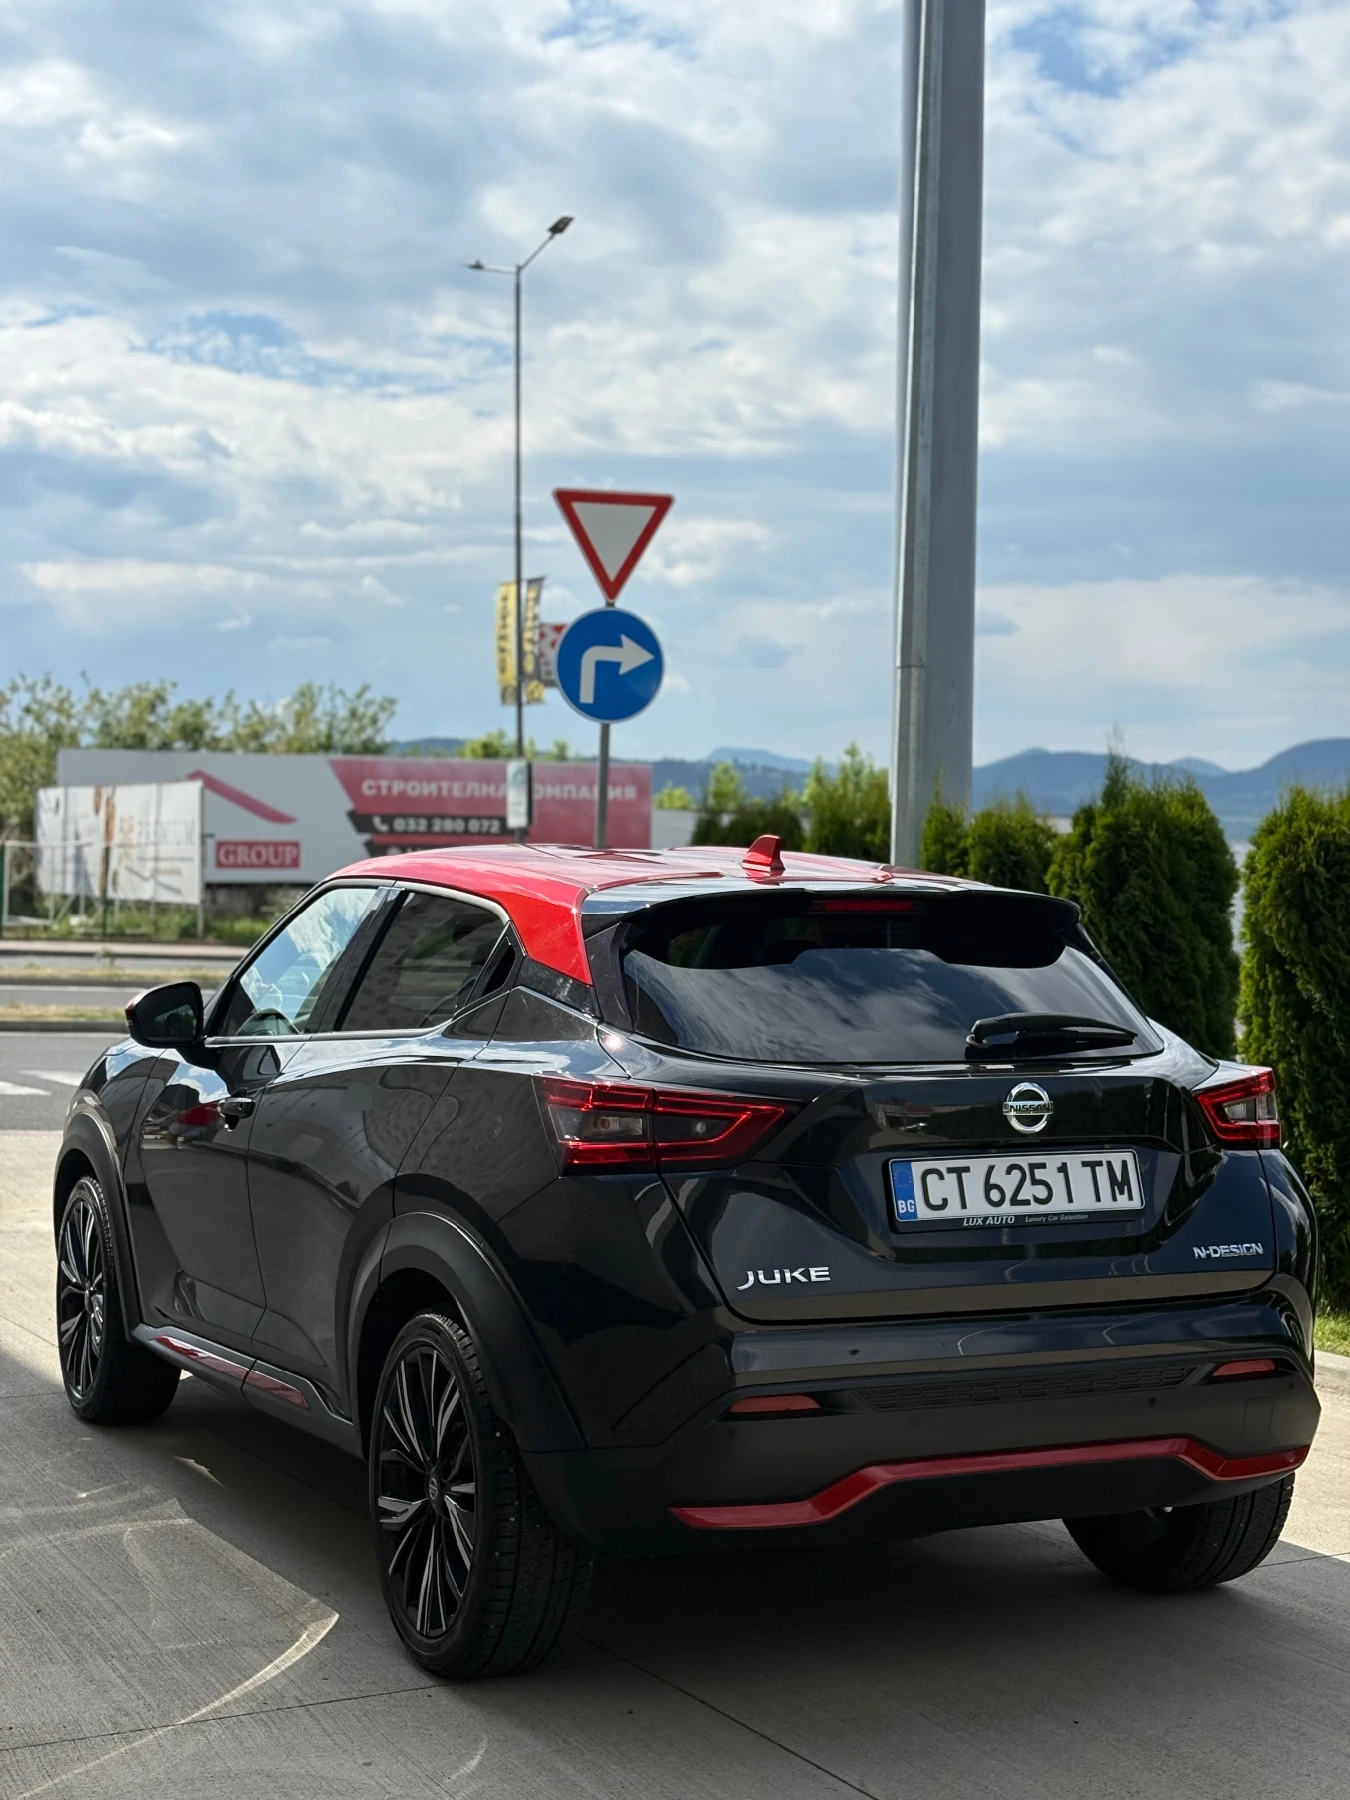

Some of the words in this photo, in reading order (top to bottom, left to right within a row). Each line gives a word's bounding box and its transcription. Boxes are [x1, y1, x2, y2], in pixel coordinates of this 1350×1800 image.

[393, 817, 428, 832] 032
[218, 843, 298, 866] GROUP
[1009, 1102, 1053, 1113] NISSAN
[898, 1199, 915, 1213] BG
[921, 1165, 971, 1212] CT
[983, 1161, 1074, 1208] 6251
[1081, 1159, 1135, 1203] TM
[963, 1217, 984, 1227] LUX
[985, 1215, 1015, 1226] AUTO
[1025, 1215, 1047, 1224] Luxury
[1060, 1213, 1089, 1221] Selection
[1192, 1243, 1264, 1259] N-DESIGN
[736, 1266, 832, 1291] JUKE
